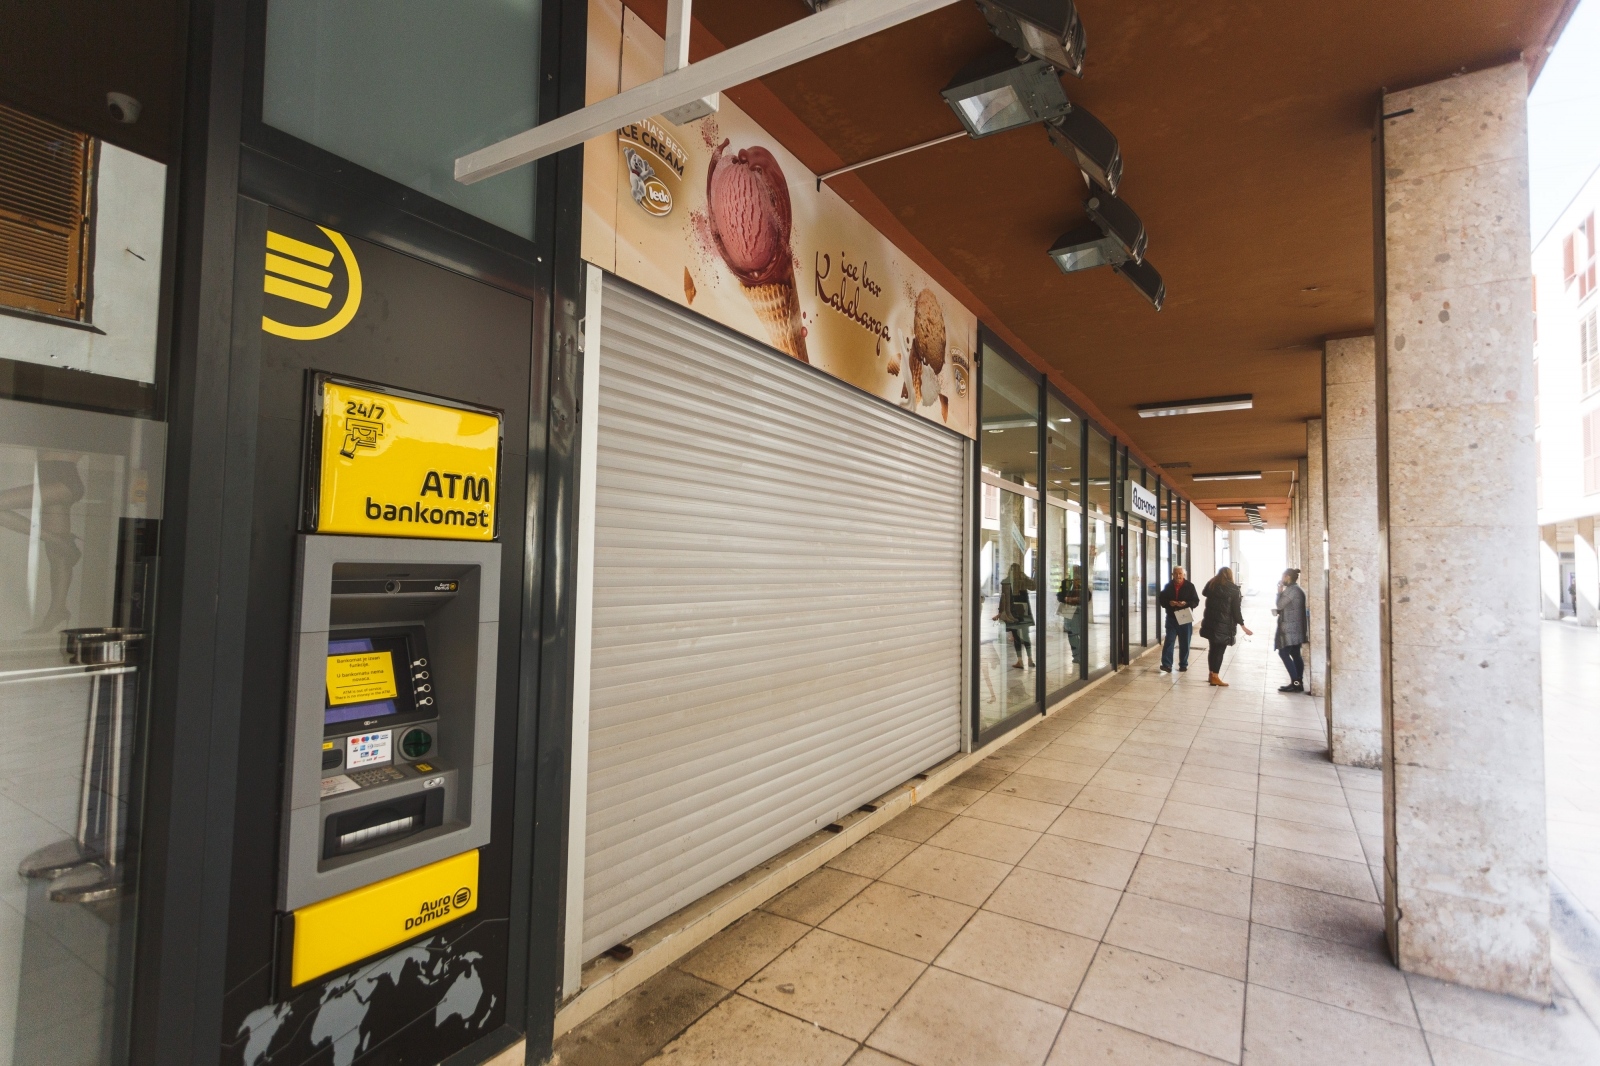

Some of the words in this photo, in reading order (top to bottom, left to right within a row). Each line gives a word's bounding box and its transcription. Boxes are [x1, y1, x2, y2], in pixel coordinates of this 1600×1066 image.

[642, 132, 684, 176] CREAM
[665, 136, 688, 164] BEST
[840, 251, 859, 282] ice
[862, 261, 881, 298] bar
[815, 251, 892, 356] Kalelarga
[346, 401, 384, 419] 24/7
[420, 471, 490, 502] ATM
[366, 497, 489, 528] bankomat
[405, 905, 450, 931] Domus
[420, 895, 451, 914] Auro
